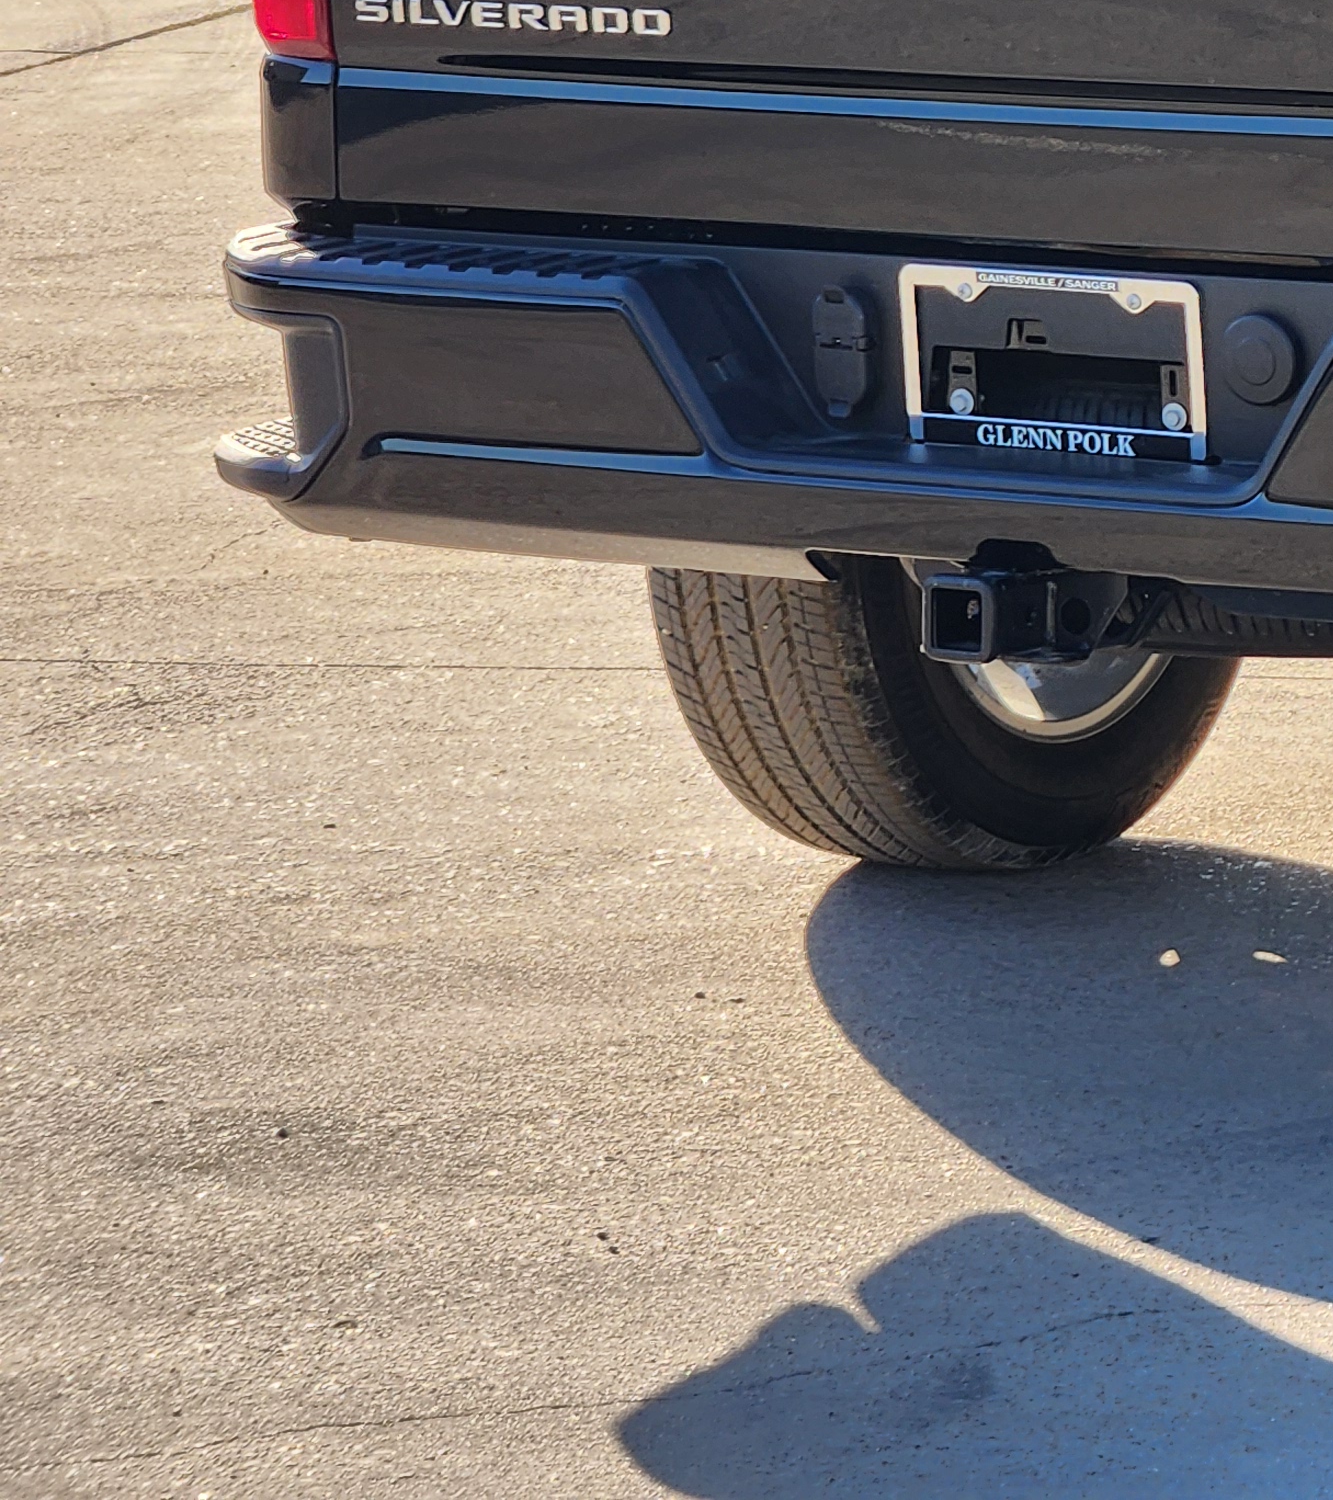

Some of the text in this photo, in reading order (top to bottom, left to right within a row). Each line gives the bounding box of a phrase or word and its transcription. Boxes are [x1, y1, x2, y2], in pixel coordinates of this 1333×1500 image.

[977, 272, 1056, 287] GAINESVILLE
[1064, 278, 1117, 291] SANGER
[976, 423, 1137, 457] GLENN POLK
